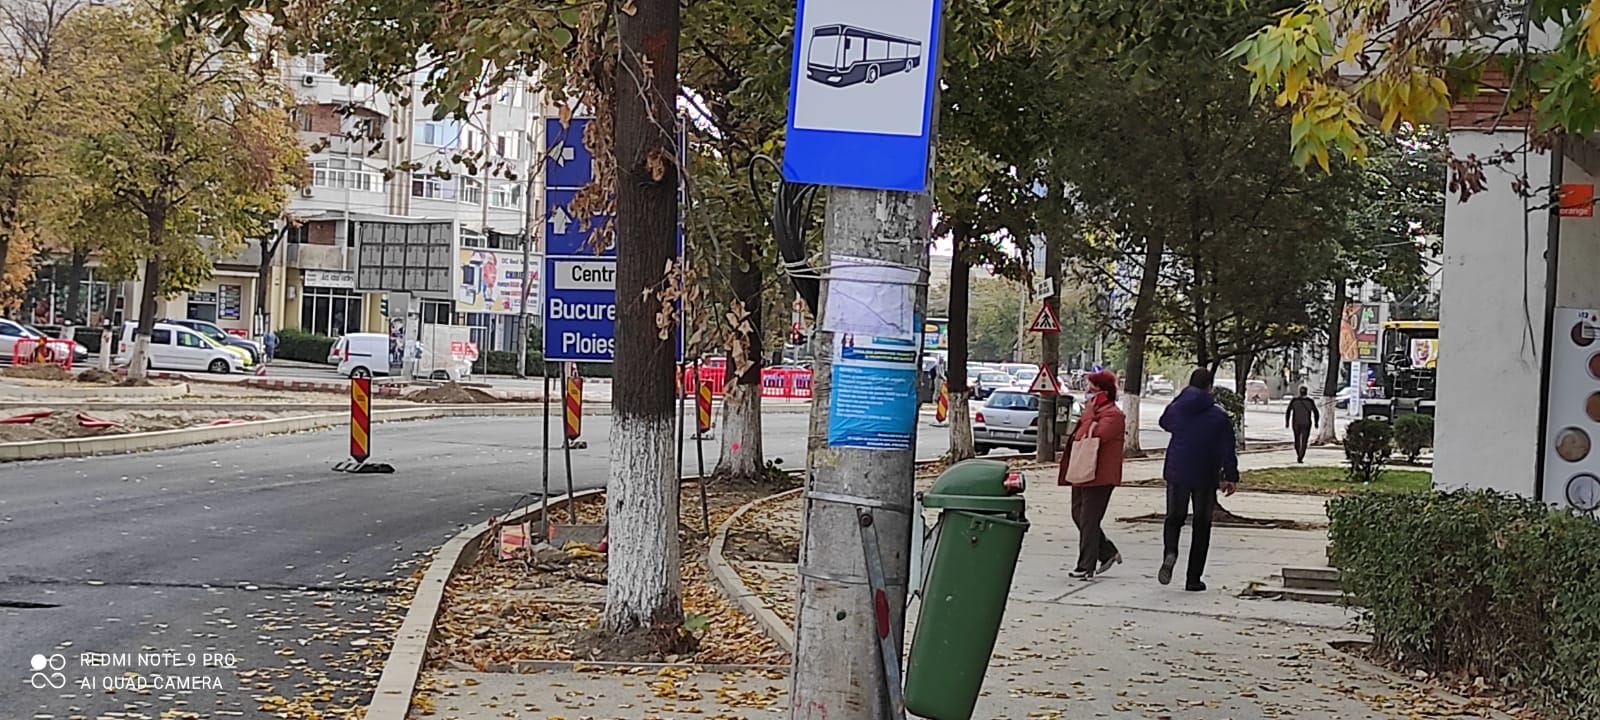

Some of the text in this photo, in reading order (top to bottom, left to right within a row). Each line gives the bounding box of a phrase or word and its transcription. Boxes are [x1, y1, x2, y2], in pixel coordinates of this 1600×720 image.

[1559, 208, 1588, 216] orange
[572, 265, 615, 282] Centr
[550, 298, 616, 320] Bucure
[562, 332, 615, 358] Ploieș
